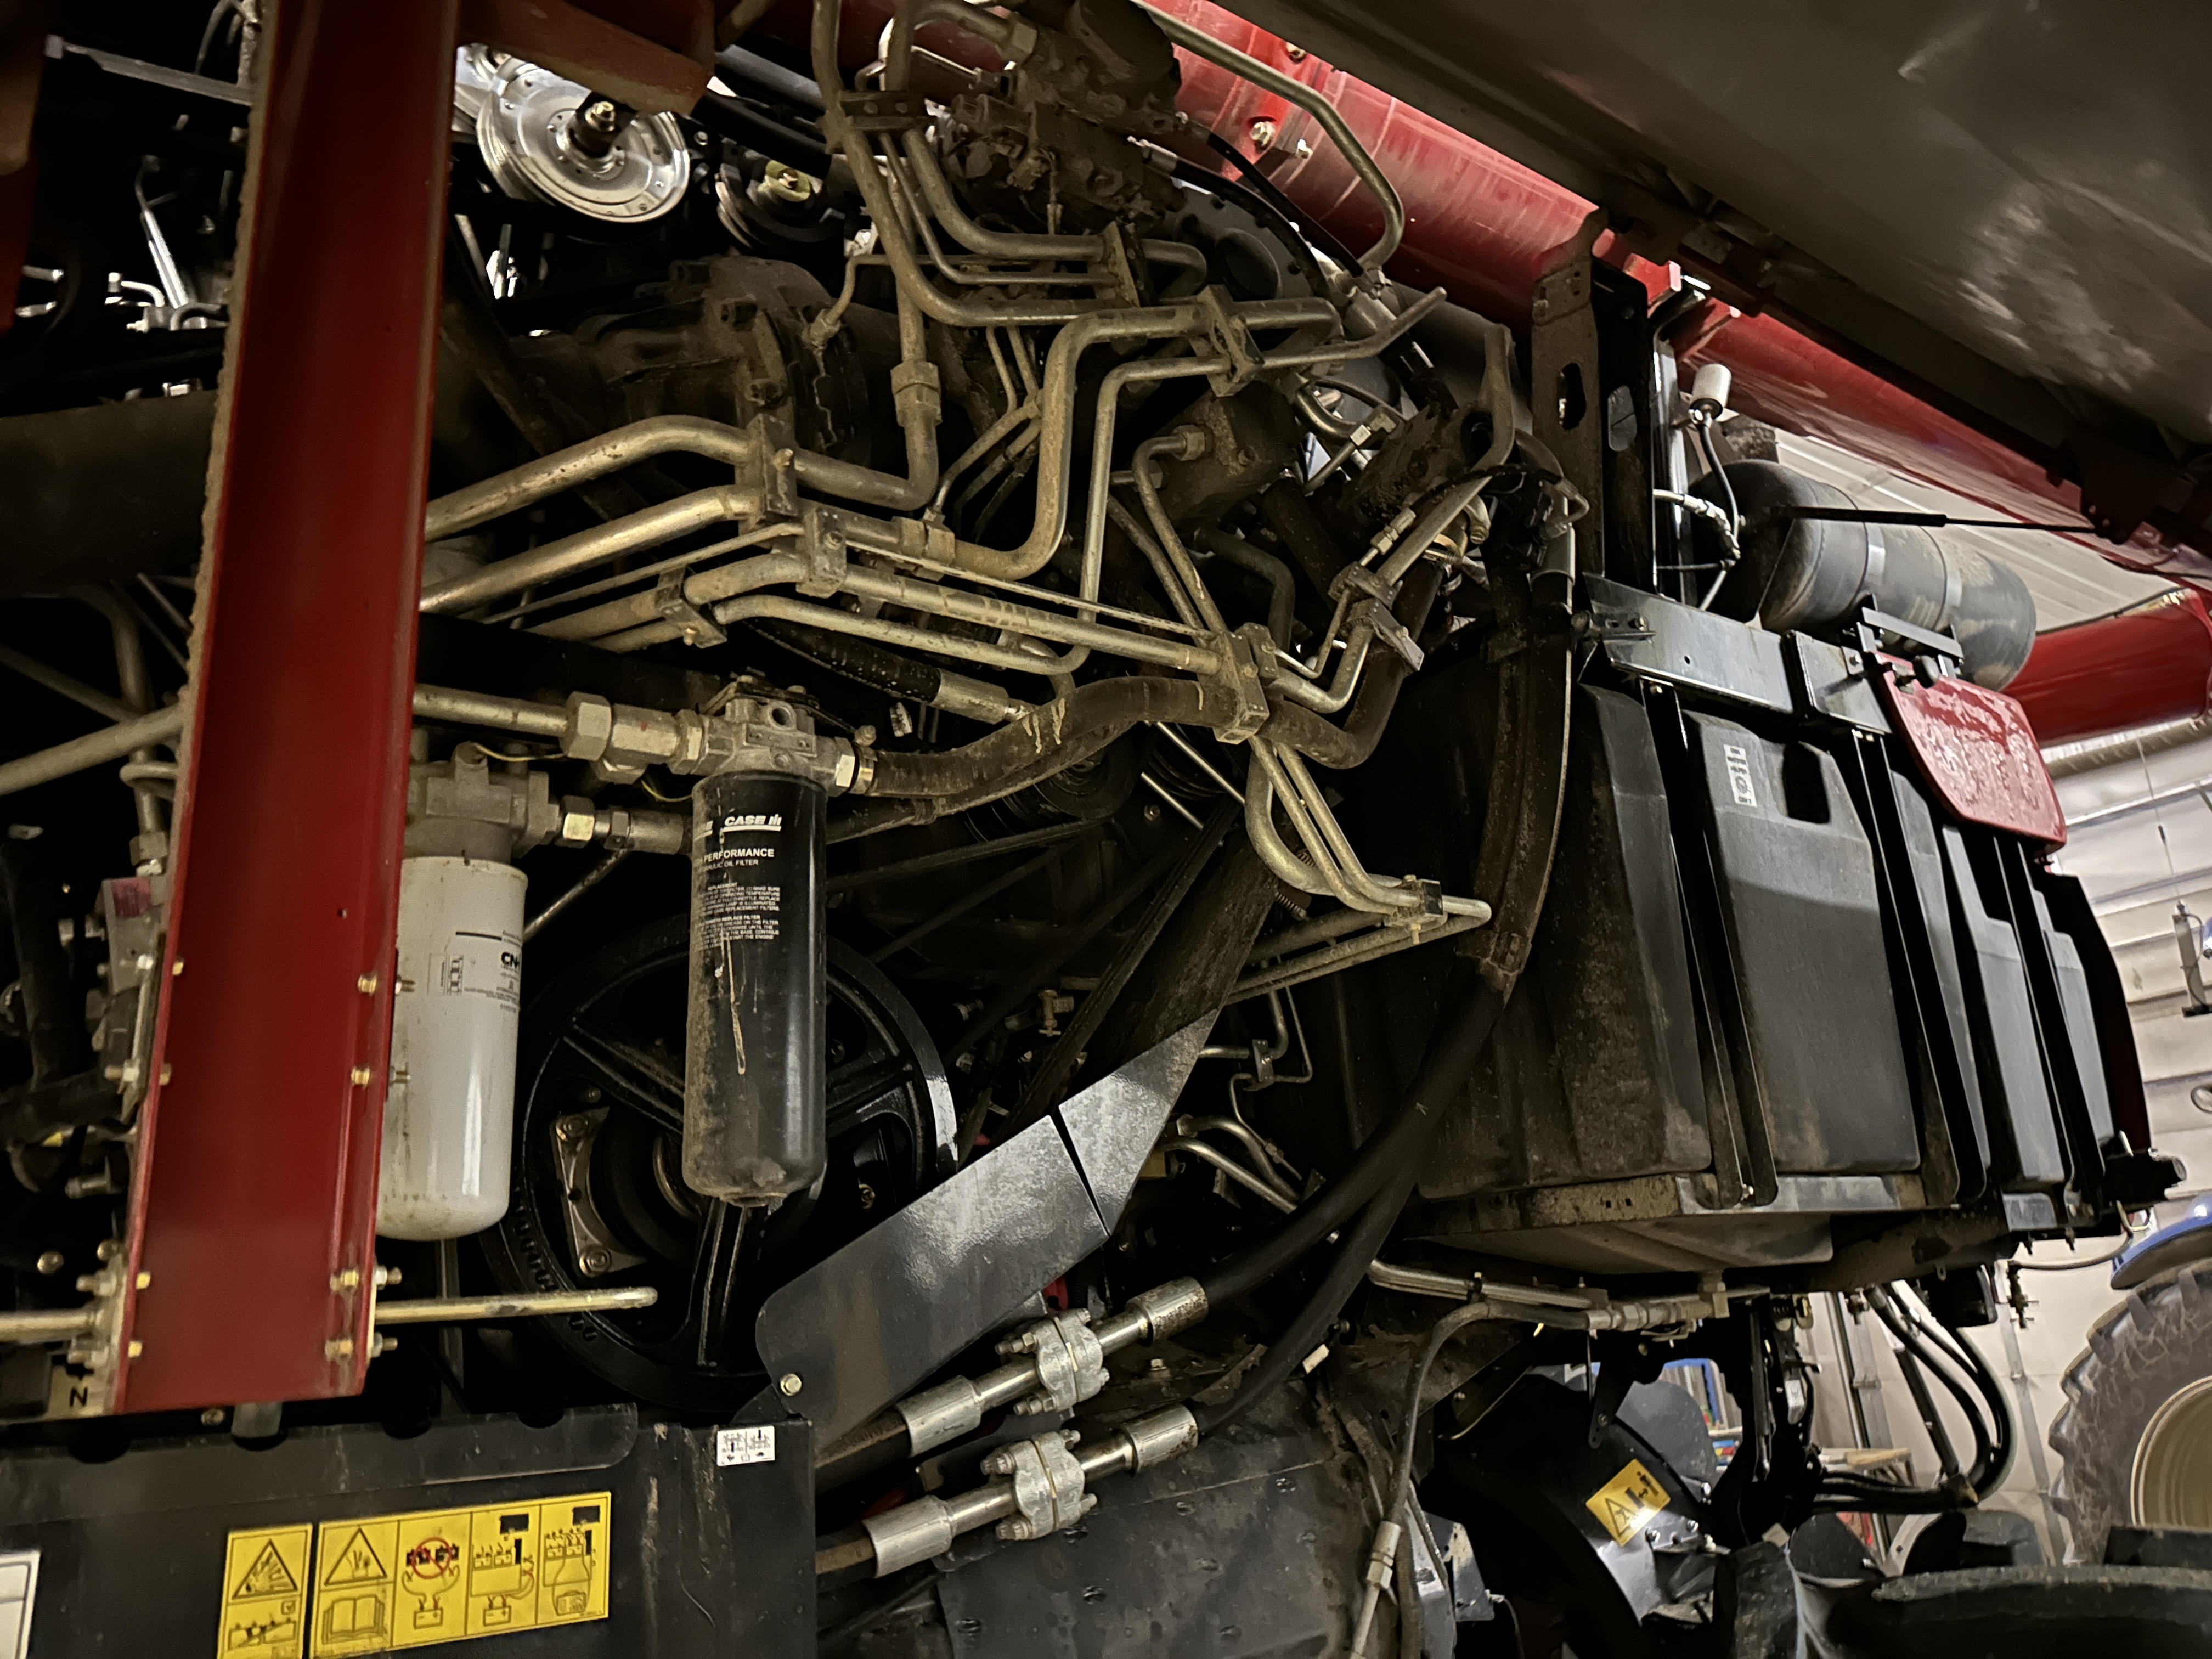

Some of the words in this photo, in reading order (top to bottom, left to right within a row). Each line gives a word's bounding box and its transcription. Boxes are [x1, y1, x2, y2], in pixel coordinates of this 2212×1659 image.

[725, 815, 766, 826] CASE
[704, 848, 775, 862] PERFORMANCE
[69, 1386, 88, 1407] N
